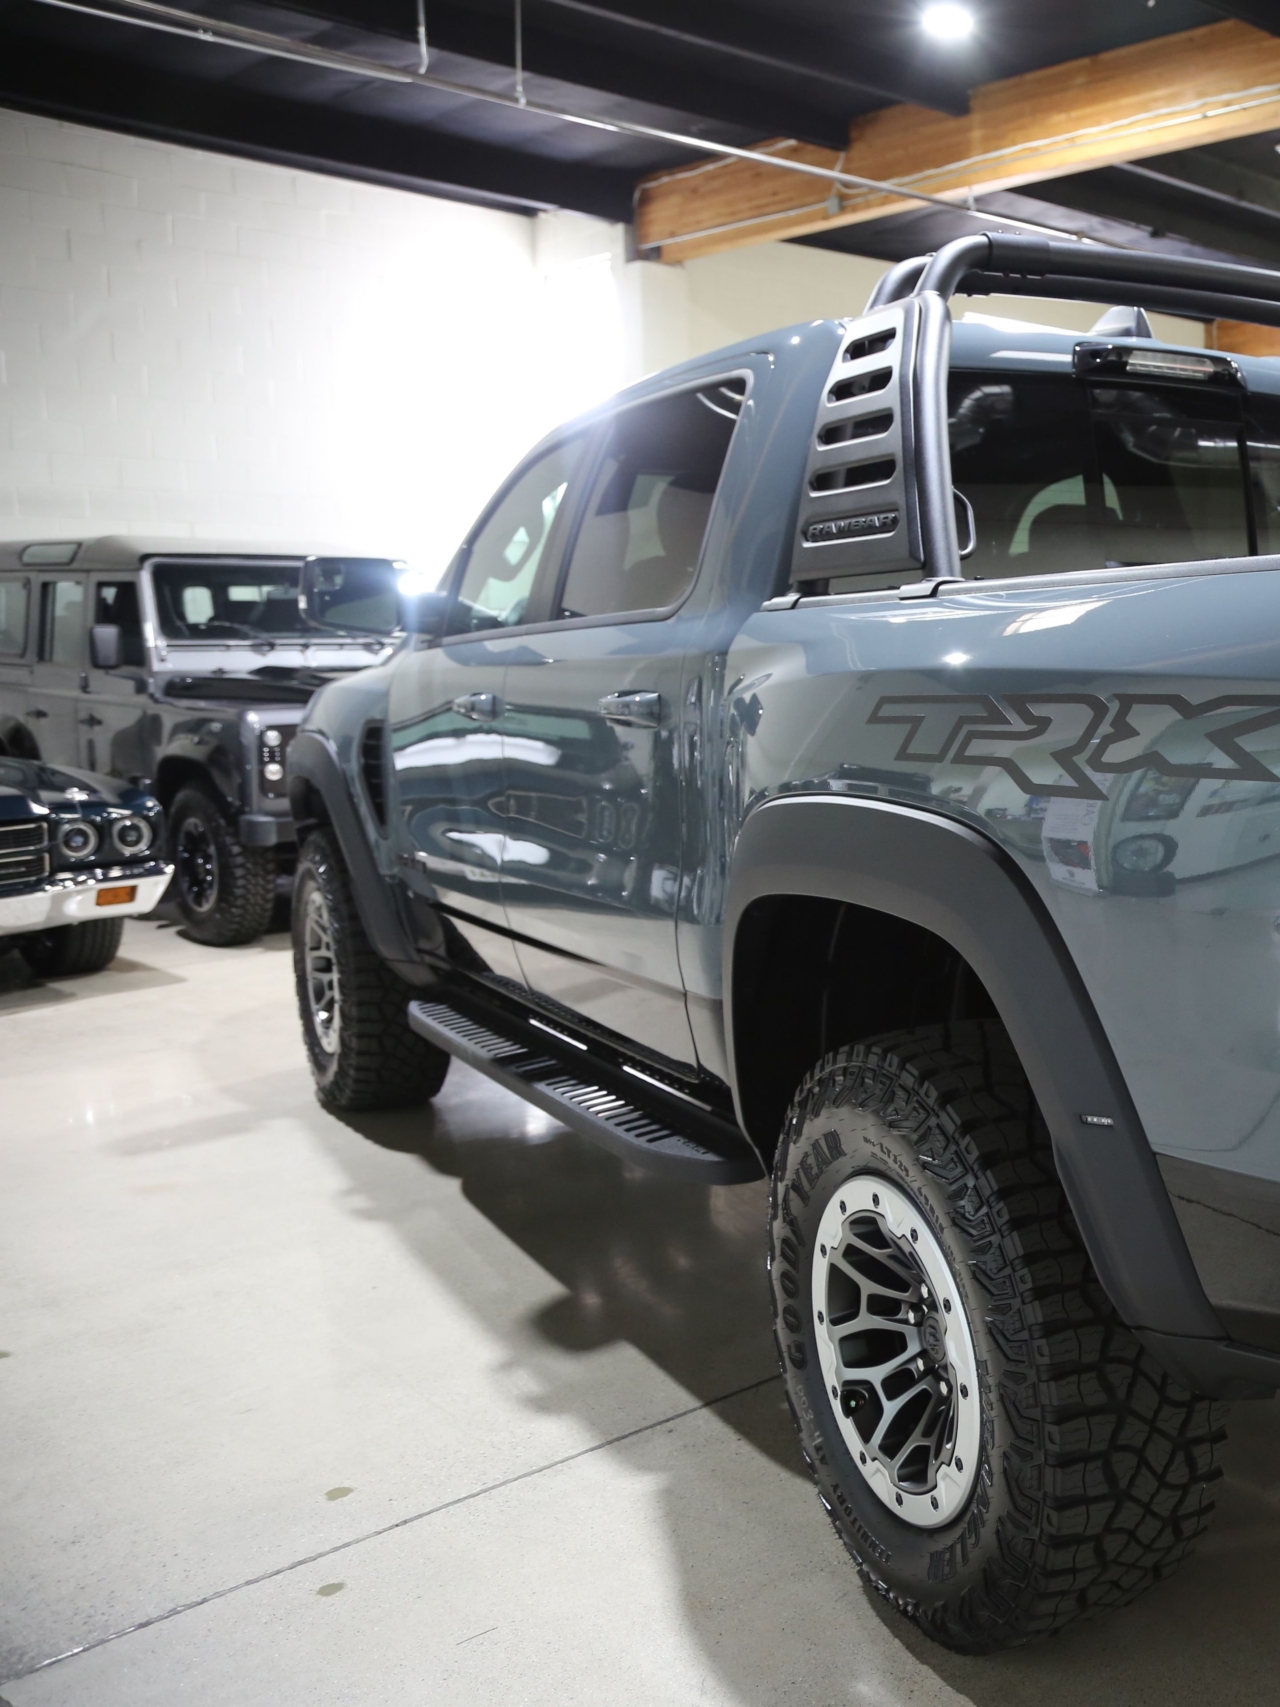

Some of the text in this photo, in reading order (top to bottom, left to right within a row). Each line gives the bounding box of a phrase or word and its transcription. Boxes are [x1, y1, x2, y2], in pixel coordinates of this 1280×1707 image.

[806, 513, 896, 541] RAMBAR
[778, 1128, 847, 1371] GOODYEAR
[829, 1481, 893, 1567] TERRITORY
[926, 1358, 995, 1582] WRANGLER
